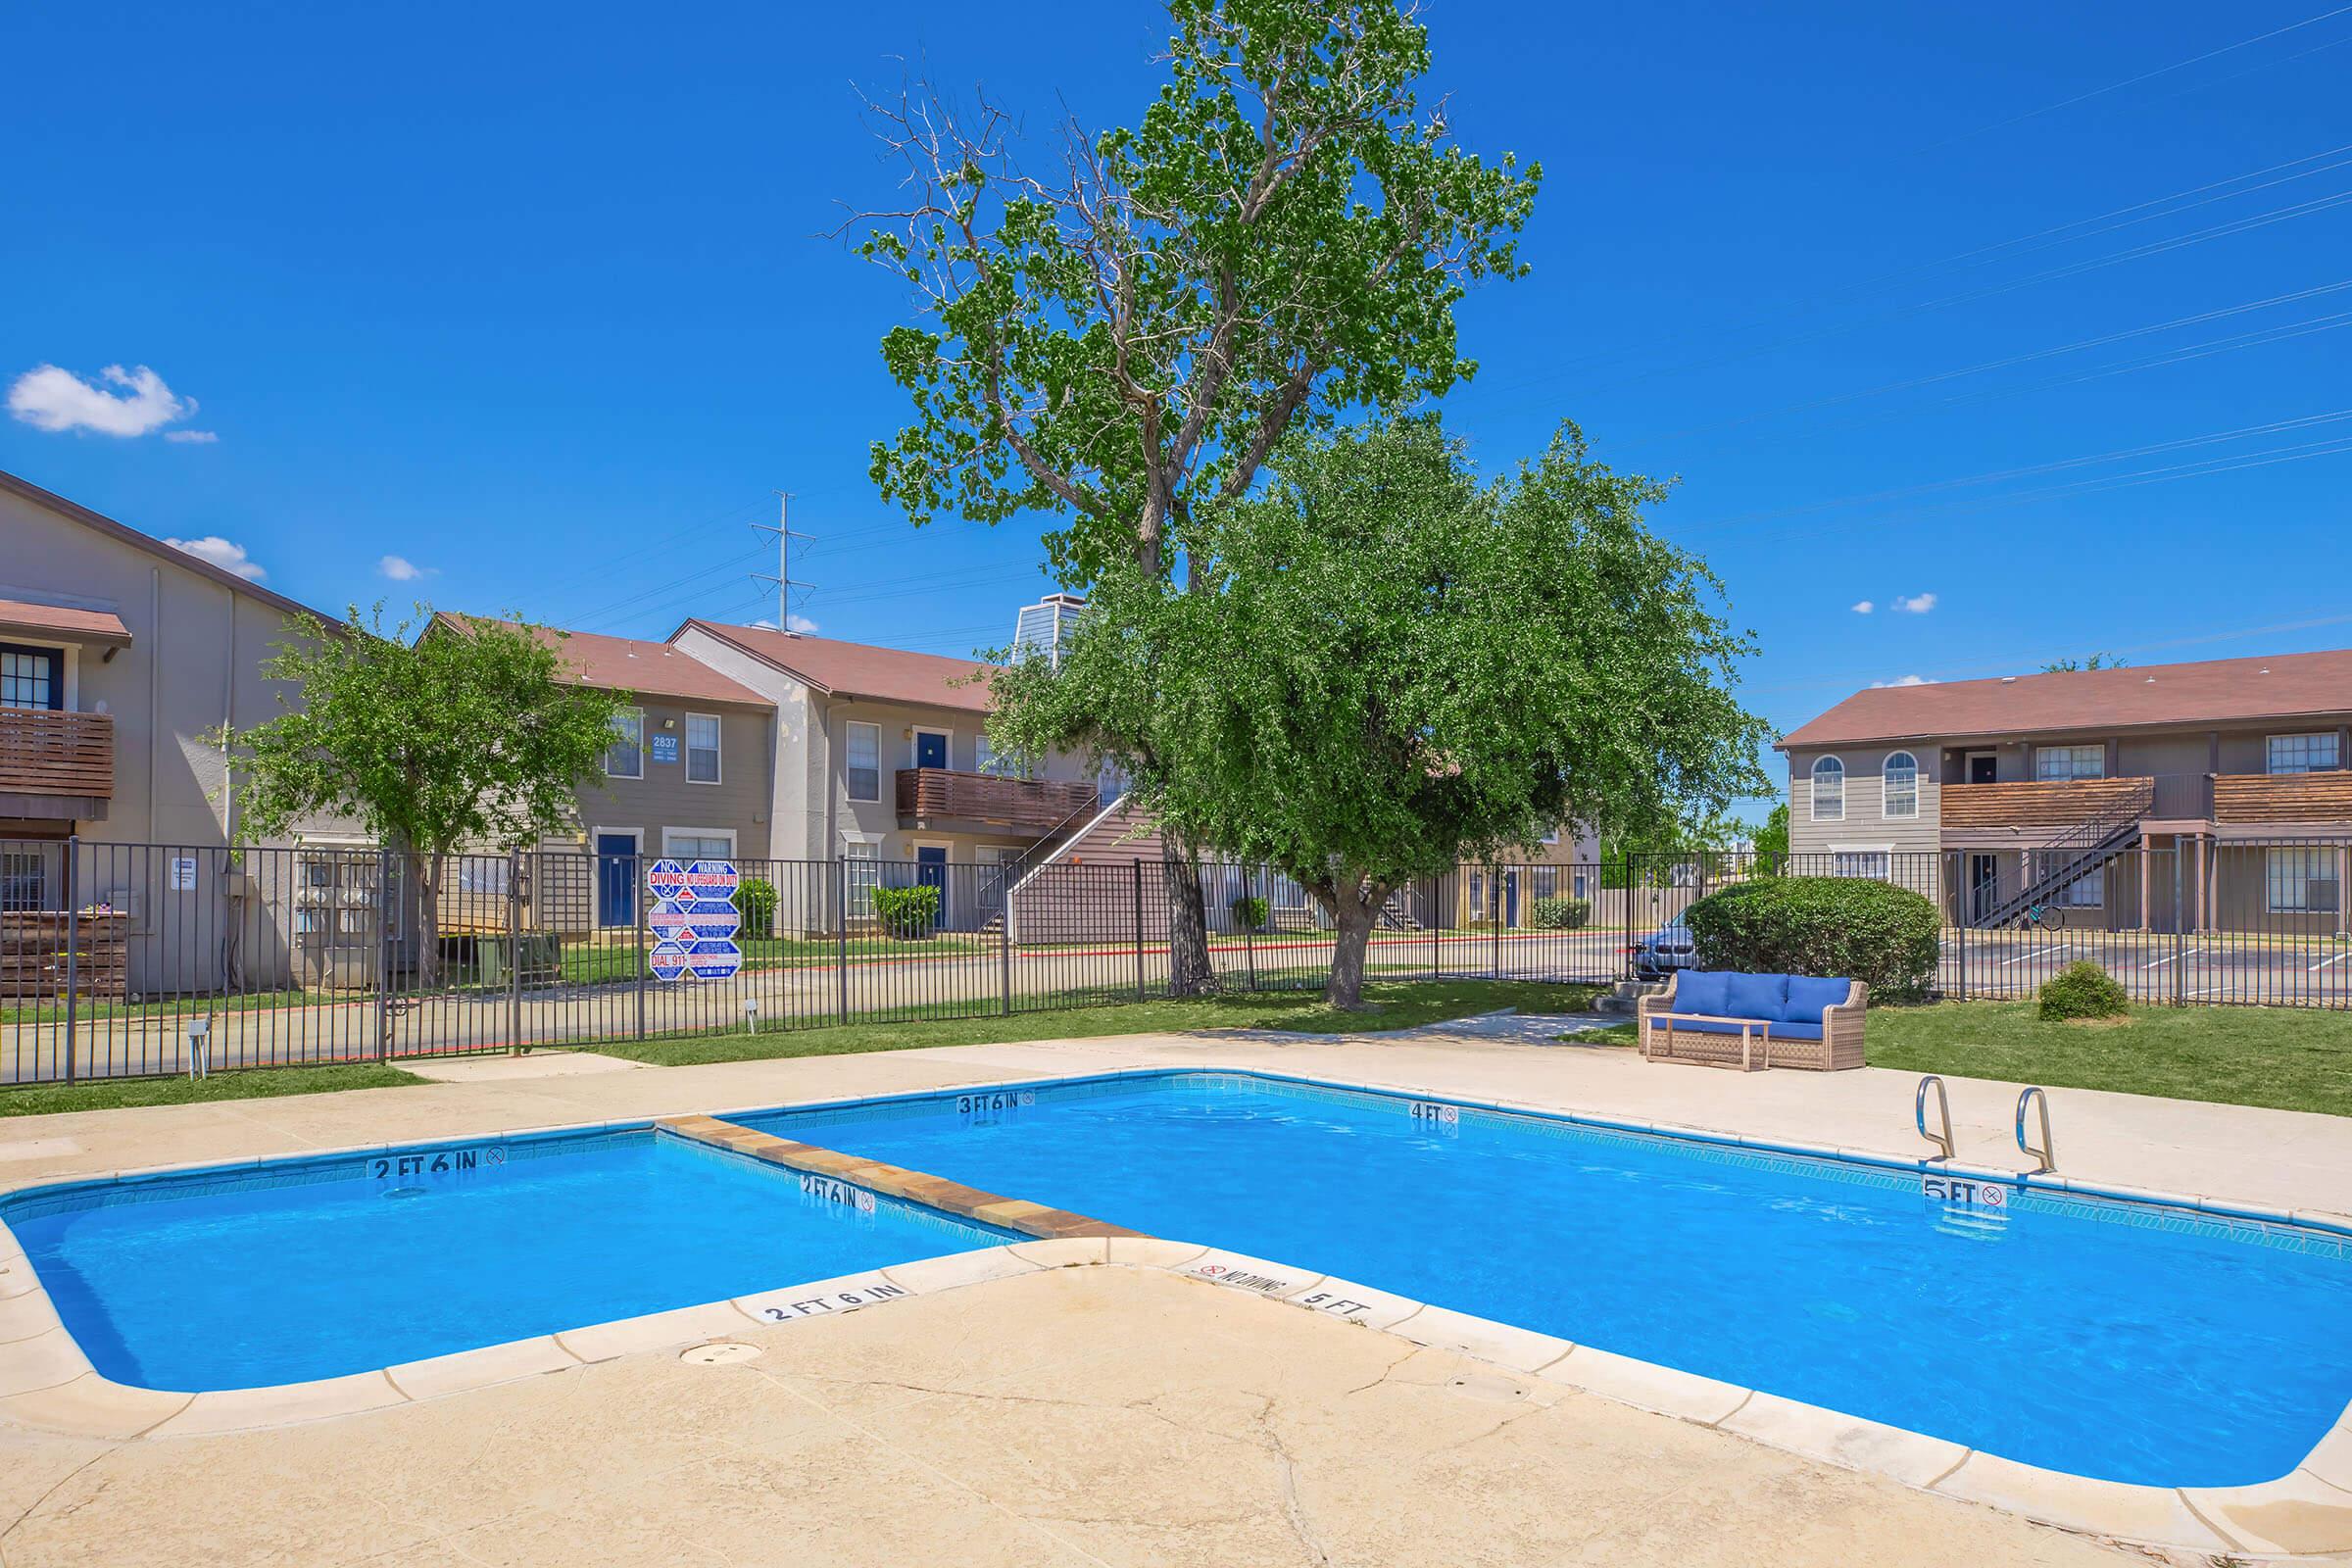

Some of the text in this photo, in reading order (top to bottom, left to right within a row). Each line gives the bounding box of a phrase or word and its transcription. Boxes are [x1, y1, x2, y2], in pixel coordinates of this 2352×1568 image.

[653, 736, 676, 748] 2837
[661, 861, 675, 872] NO
[698, 862, 728, 874] WARNING
[650, 872, 685, 884] DIVING
[686, 873, 738, 886] NO LIFEGUARD ON DUTY
[651, 955, 686, 966] DIAL 911
[959, 1092, 1018, 1114] 3 FT 6 IN
[1411, 1102, 1442, 1122] 4 FT
[374, 1150, 476, 1179] 2 FT 6 IN
[804, 1175, 857, 1208] 2 FT 6 IN
[1924, 1179, 1977, 1203] 5 FT
[1218, 1270, 1249, 1282] NO
[1236, 1275, 1287, 1292] DIVING
[764, 1284, 906, 1321] 2 FT 6 IN
[1303, 1293, 1372, 1315] 5 FT
